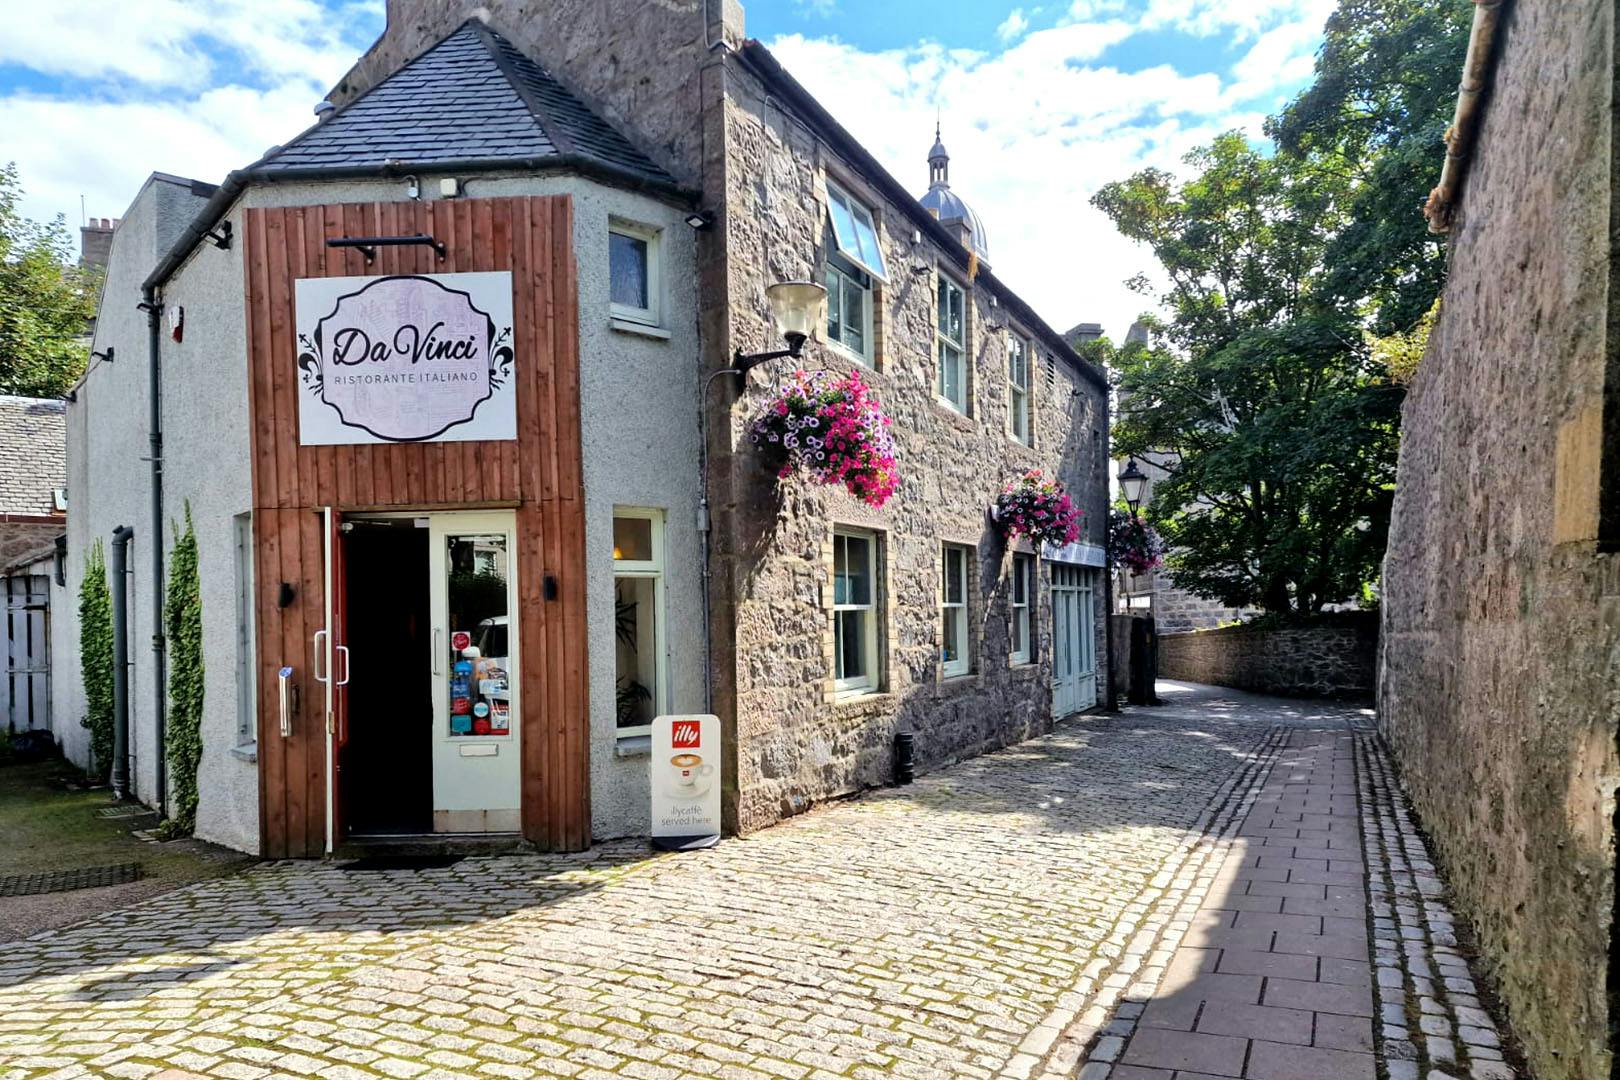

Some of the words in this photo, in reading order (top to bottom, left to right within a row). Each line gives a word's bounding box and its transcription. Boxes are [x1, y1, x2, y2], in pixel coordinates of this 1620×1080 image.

[333, 327, 392, 366] Da
[394, 321, 478, 364] Vinci
[334, 373, 415, 385] RISTORANTE
[419, 372, 478, 384] ITALIANO
[674, 724, 699, 745] illy
[661, 816, 690, 826] served
